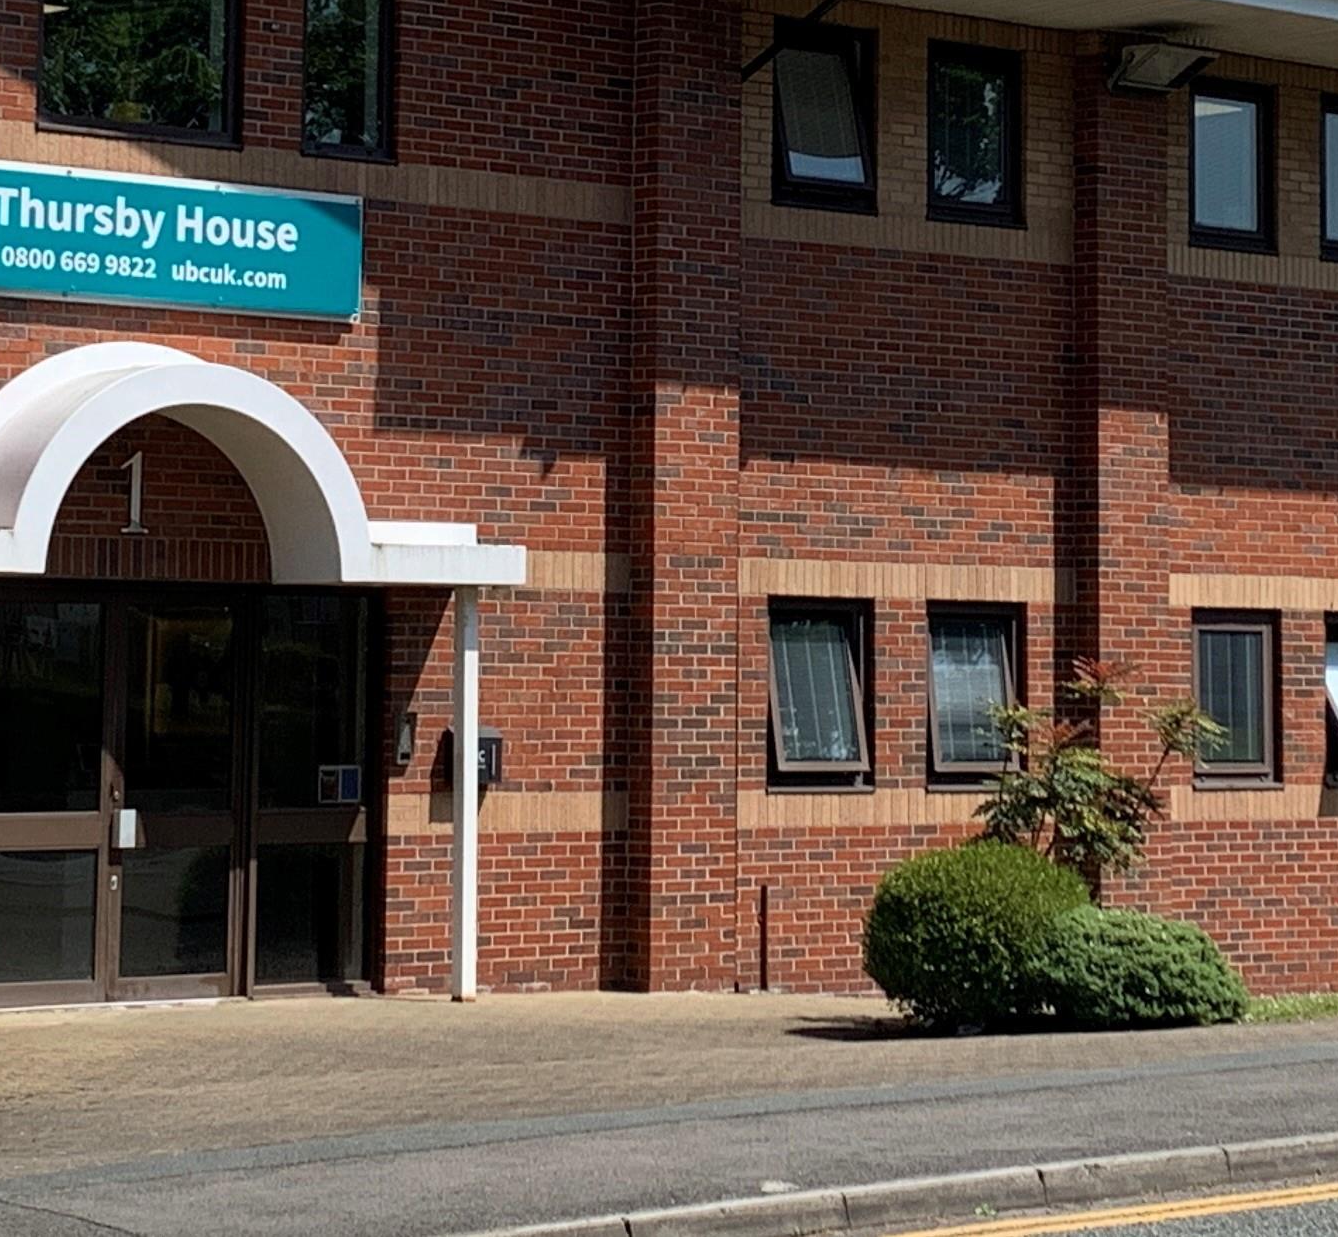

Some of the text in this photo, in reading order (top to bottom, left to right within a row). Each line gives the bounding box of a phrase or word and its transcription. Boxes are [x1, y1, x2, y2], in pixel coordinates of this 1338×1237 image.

[176, 204, 299, 252] House
[0, 246, 287, 290] 0800 669 9822 ubcuk.com
[120, 450, 149, 534] 1
